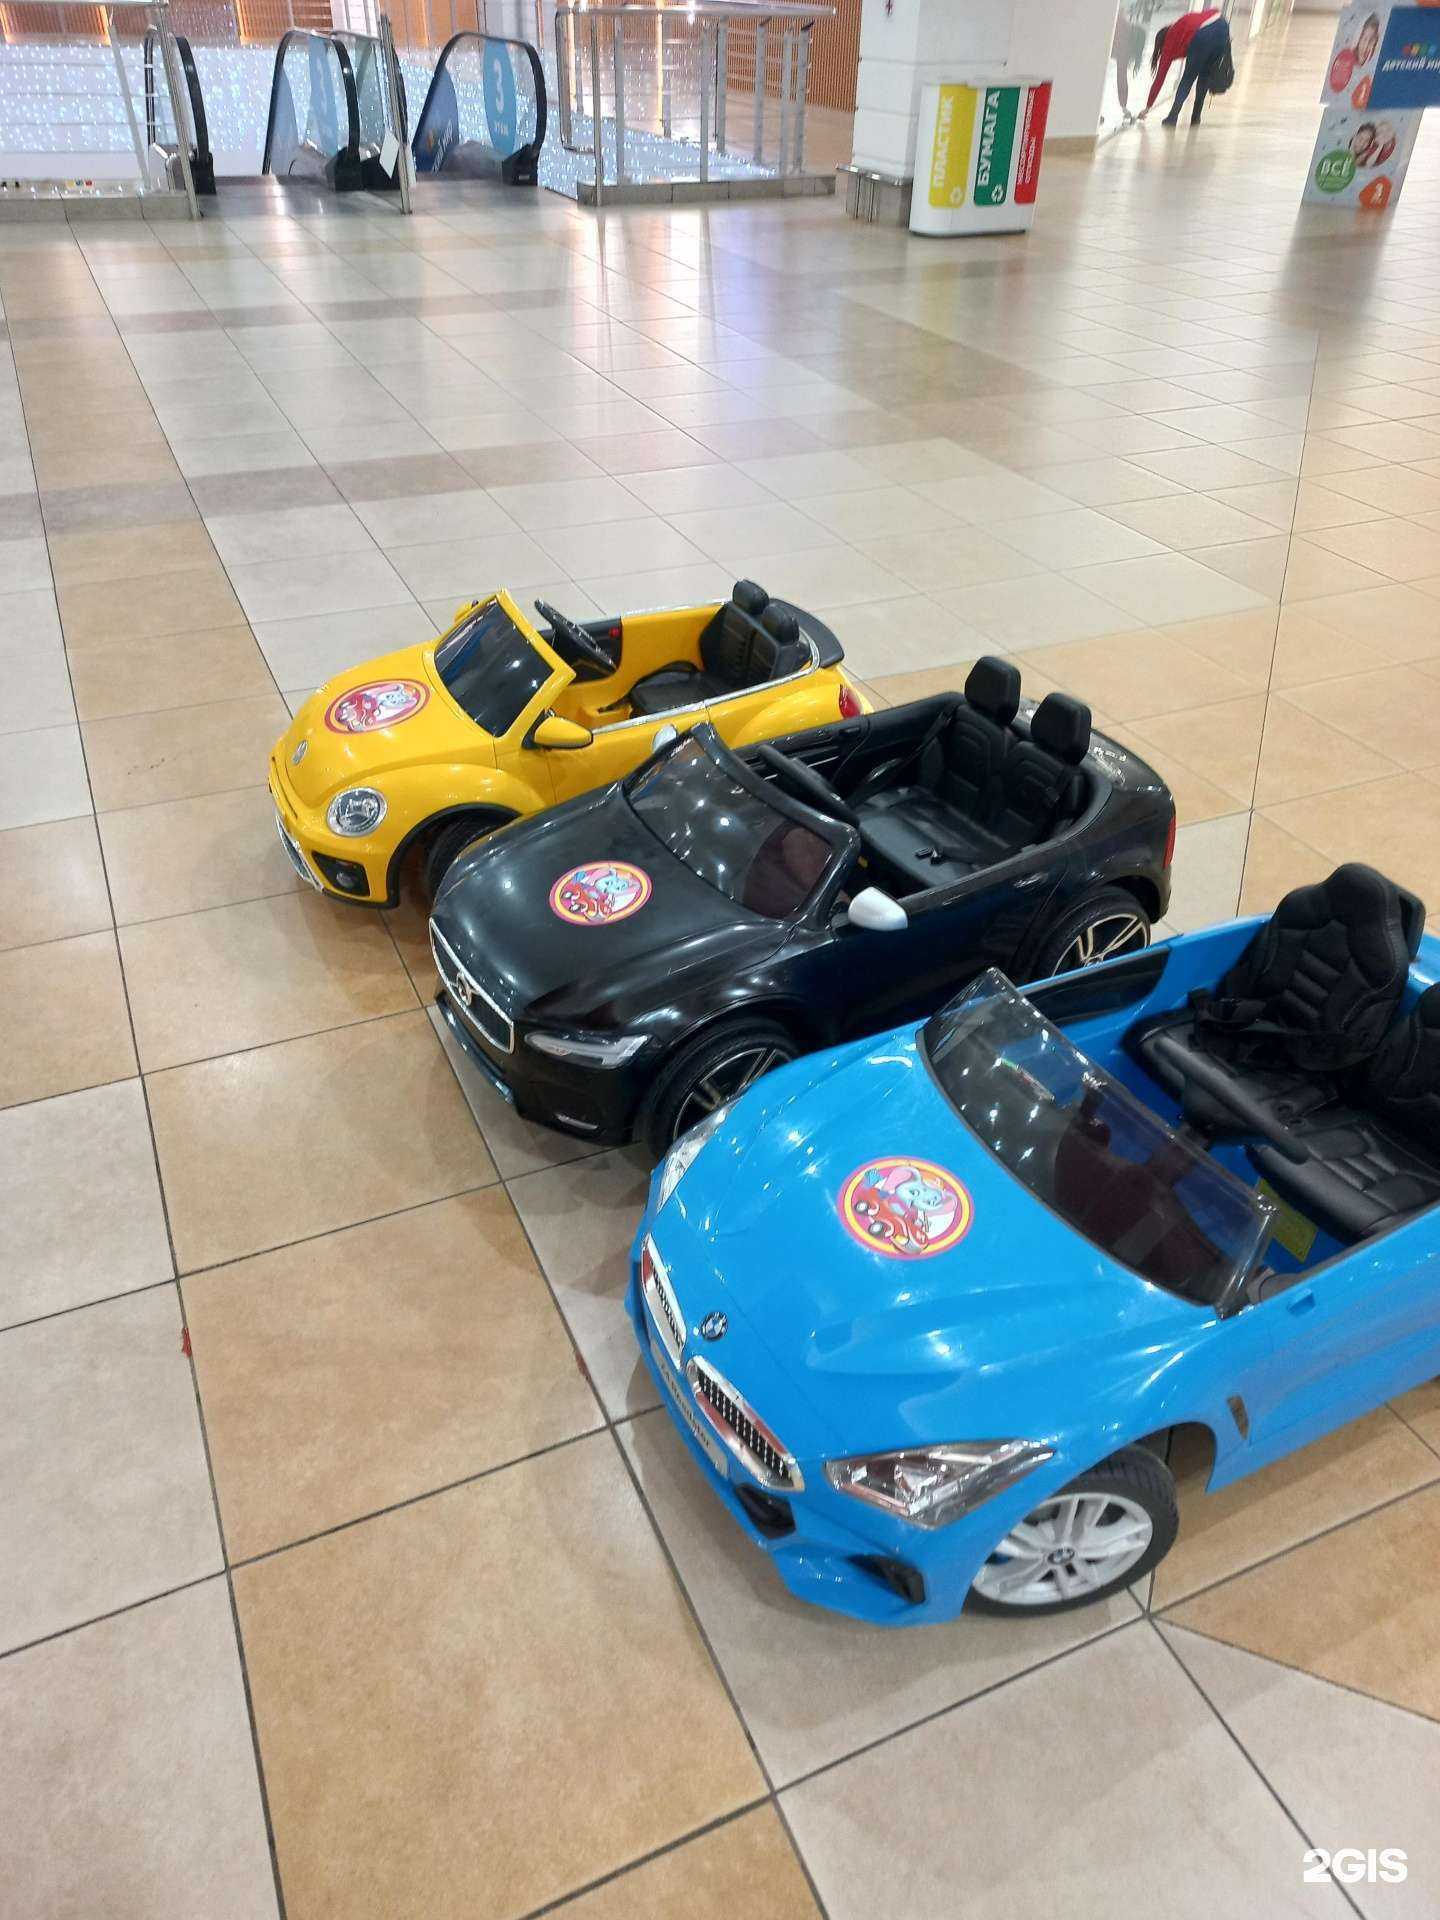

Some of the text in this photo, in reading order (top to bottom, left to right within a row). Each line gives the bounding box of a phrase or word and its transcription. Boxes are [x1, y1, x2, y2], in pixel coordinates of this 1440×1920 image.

[493, 58, 505, 115] 3
[933, 95, 954, 188] ПЛАСТИК
[977, 90, 1001, 186] БУМАГА
